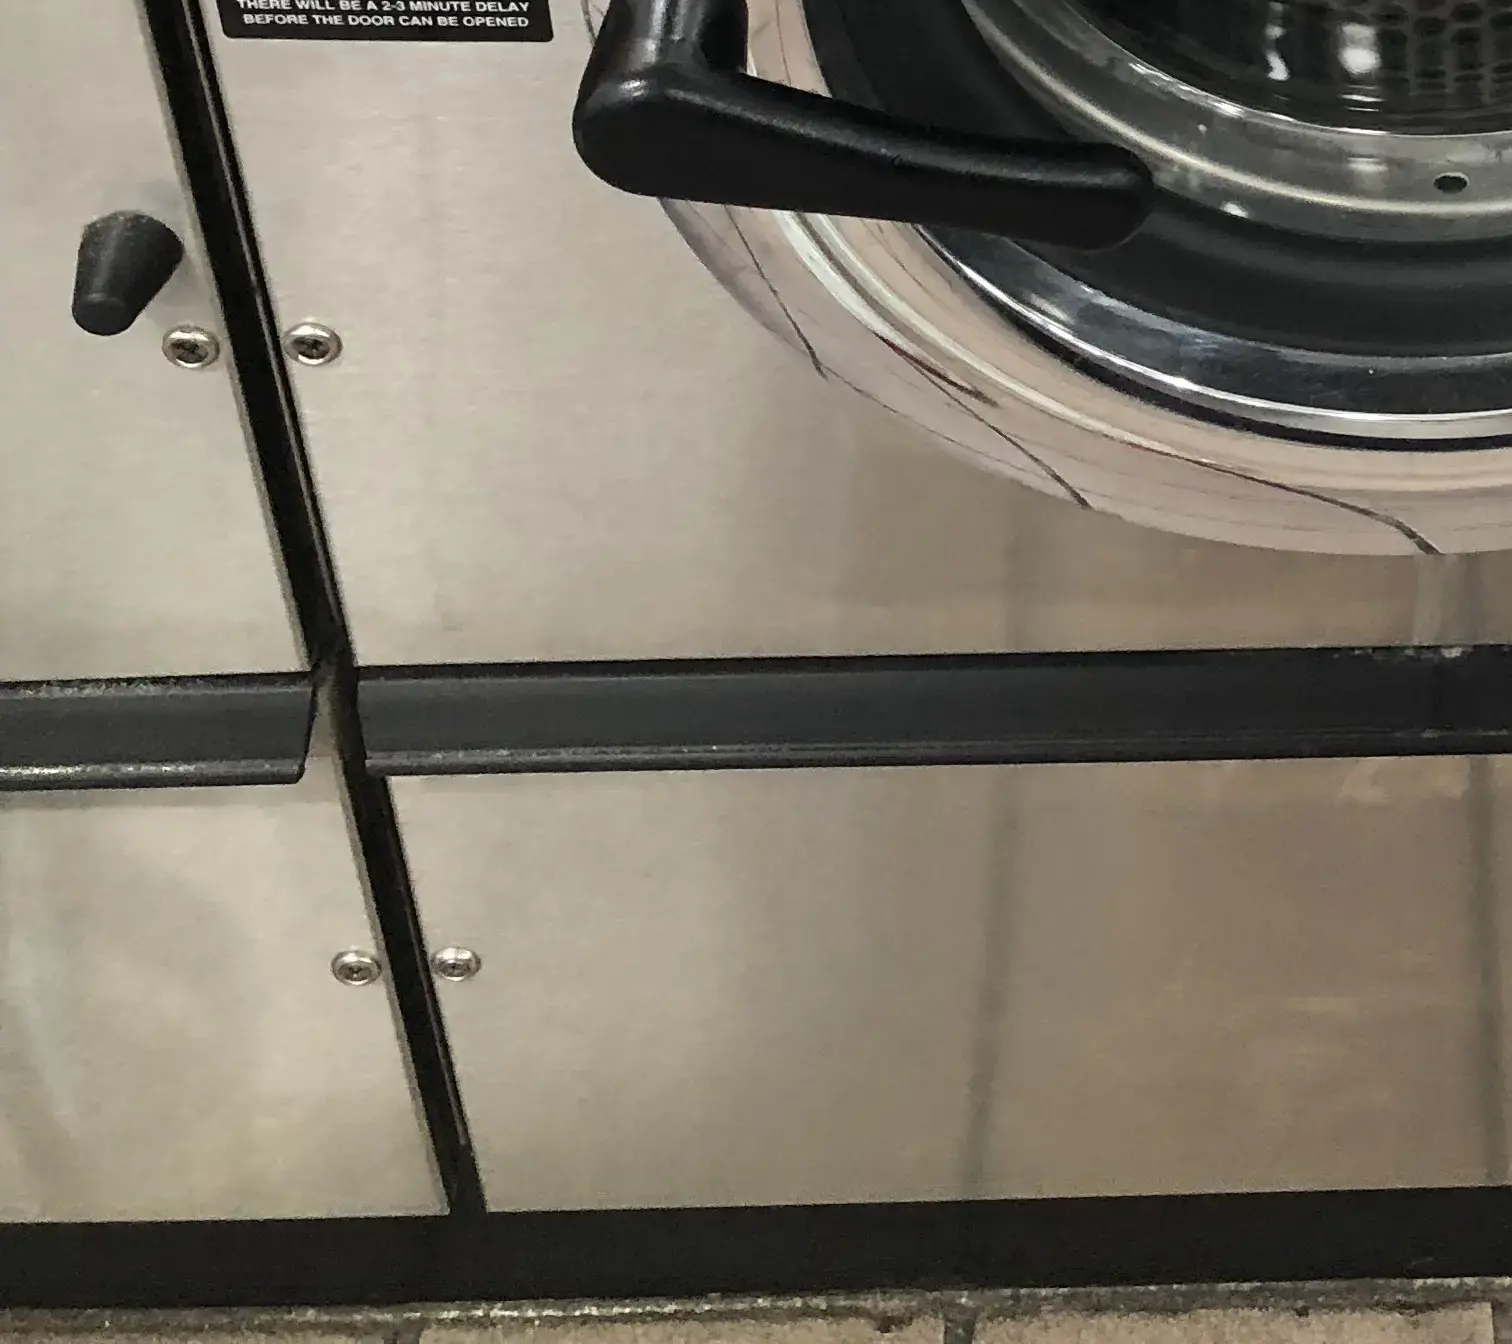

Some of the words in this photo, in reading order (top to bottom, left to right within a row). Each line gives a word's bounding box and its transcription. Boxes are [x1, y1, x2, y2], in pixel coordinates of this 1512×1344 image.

[294, 0, 336, 11] WILL
[339, 0, 362, 11] BE
[366, 0, 378, 11] A
[381, 0, 406, 12] 2-3
[409, 0, 472, 12] MINUTE
[475, 1, 530, 13] DELAY
